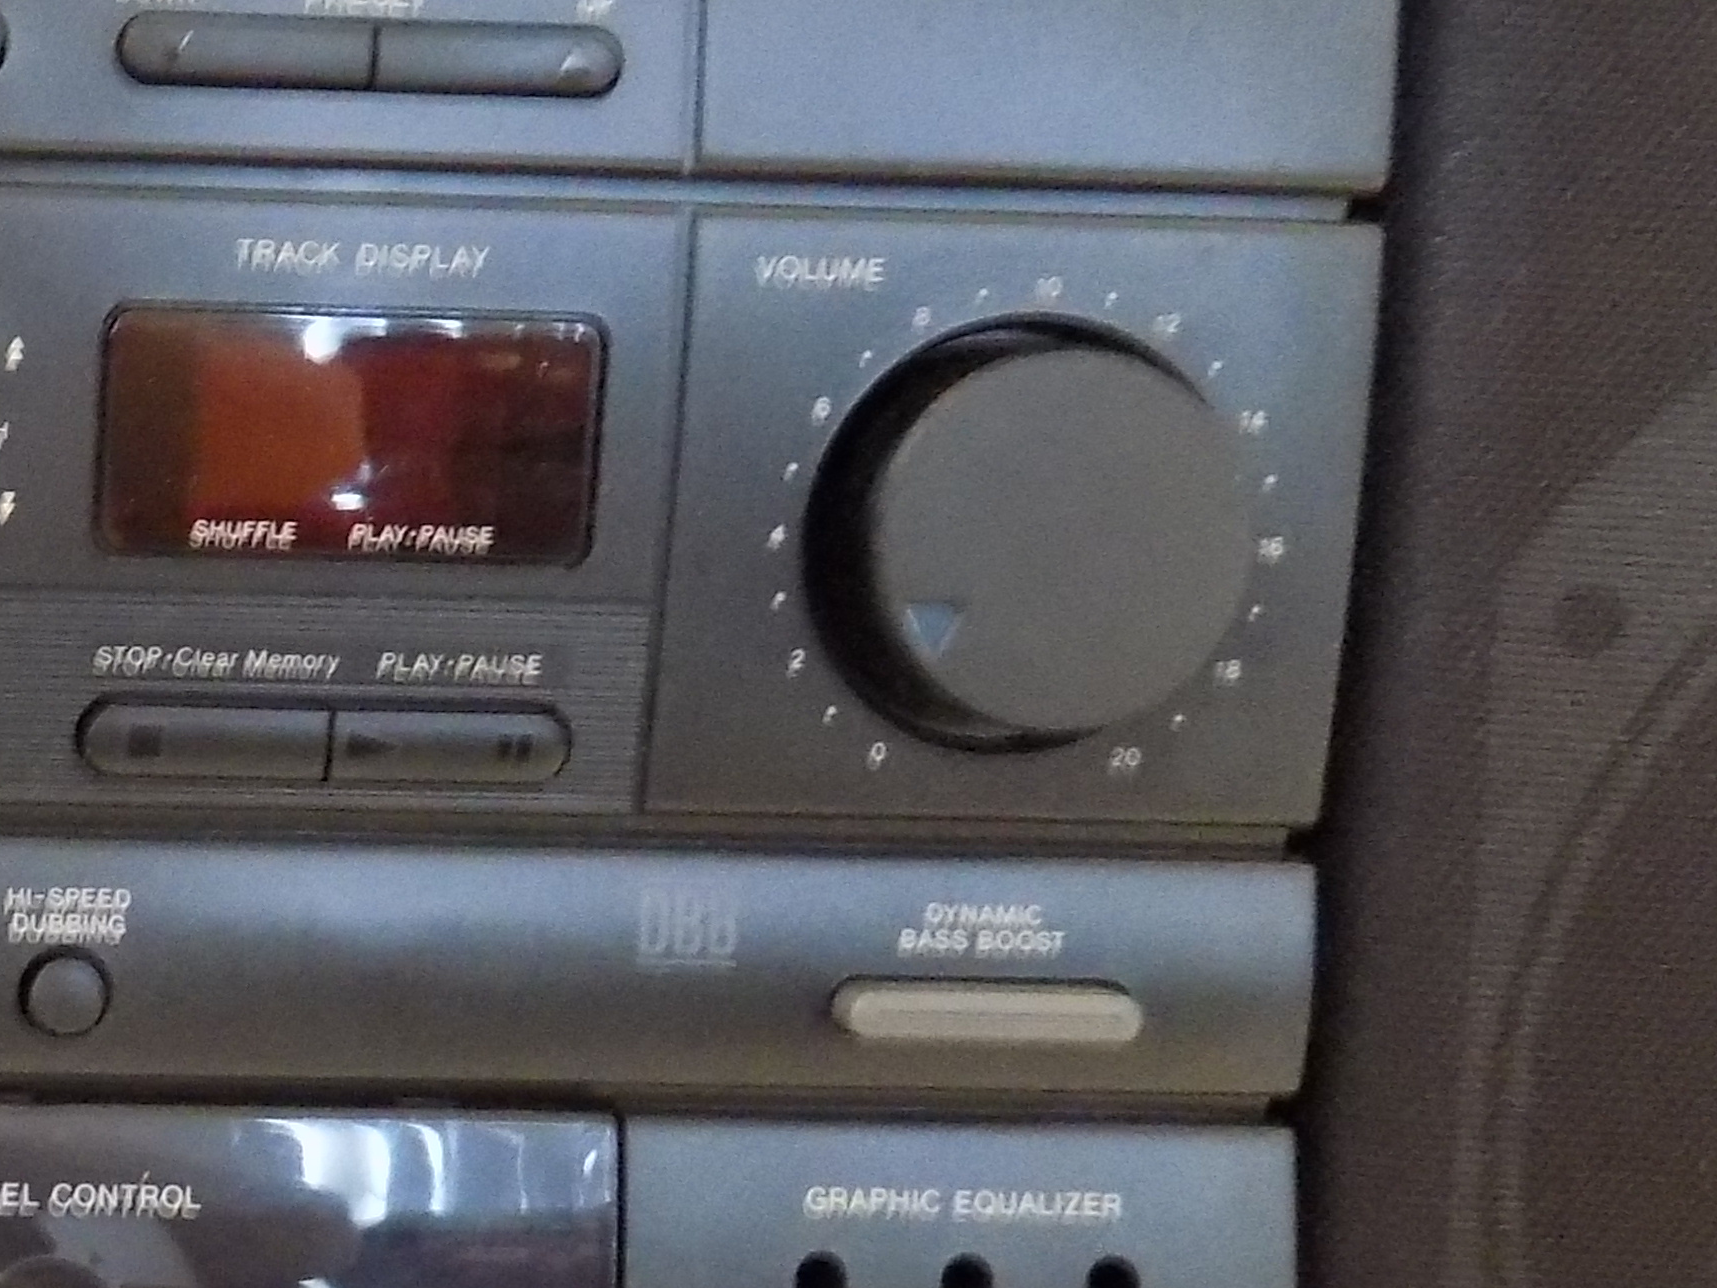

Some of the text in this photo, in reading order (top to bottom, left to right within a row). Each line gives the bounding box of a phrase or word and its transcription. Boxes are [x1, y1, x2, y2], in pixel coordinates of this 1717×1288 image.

[236, 237, 491, 279] TRACK DISPLAY
[757, 255, 886, 291] VOLUME
[189, 519, 298, 550] SHUFFLE
[242, 650, 340, 680] Memory
[786, 647, 807, 677] 2
[867, 741, 888, 771] 0
[1108, 745, 1142, 772] 20
[4, 887, 132, 917] HI-SPEED
[923, 902, 1042, 927] DYNAMIC
[7, 913, 127, 944] DUBBING
[897, 929, 1066, 960] BASS BOOST
[47, 1183, 202, 1221] CONTROL
[804, 1187, 1123, 1222] GRAPHIC EQUALIZER
